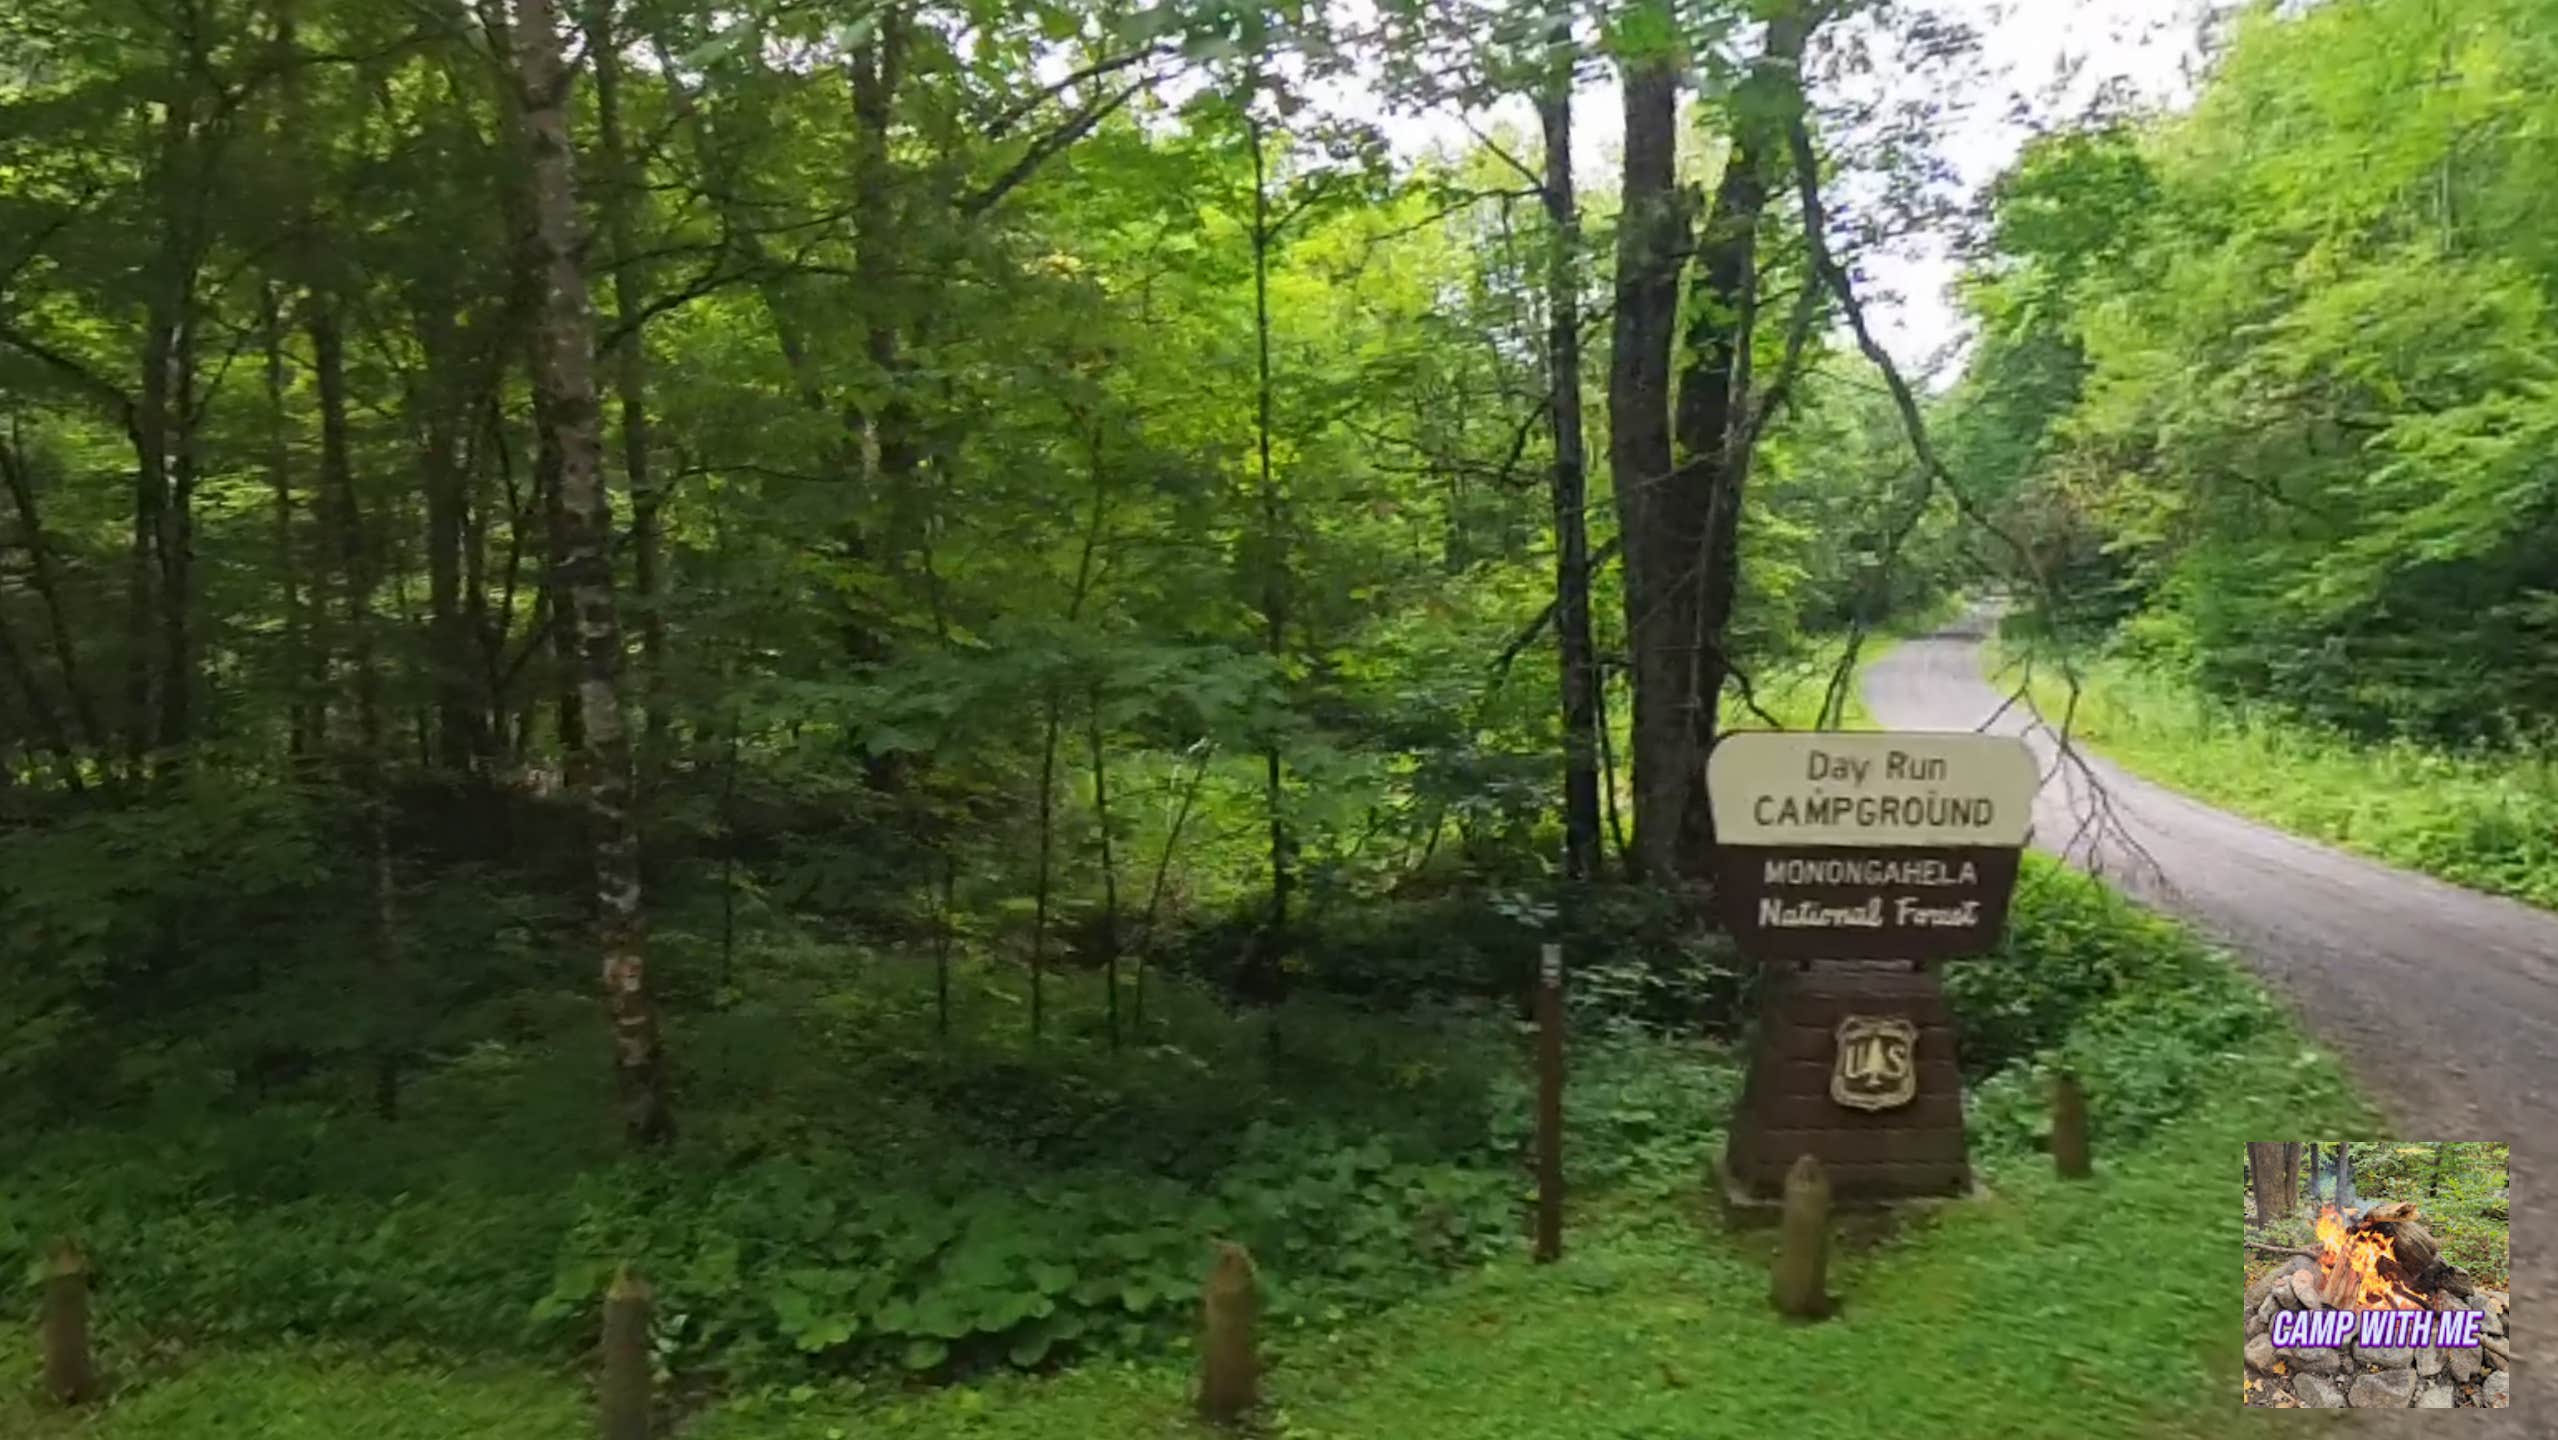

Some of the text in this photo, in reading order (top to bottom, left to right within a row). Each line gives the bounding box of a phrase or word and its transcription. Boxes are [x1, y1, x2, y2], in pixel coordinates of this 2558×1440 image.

[1808, 751, 1946, 785] Day Run
[1754, 795, 1993, 827] CAMPGROUND
[1764, 860, 1978, 885] MONONGAHELA
[1758, 898, 1980, 927] National Forest
